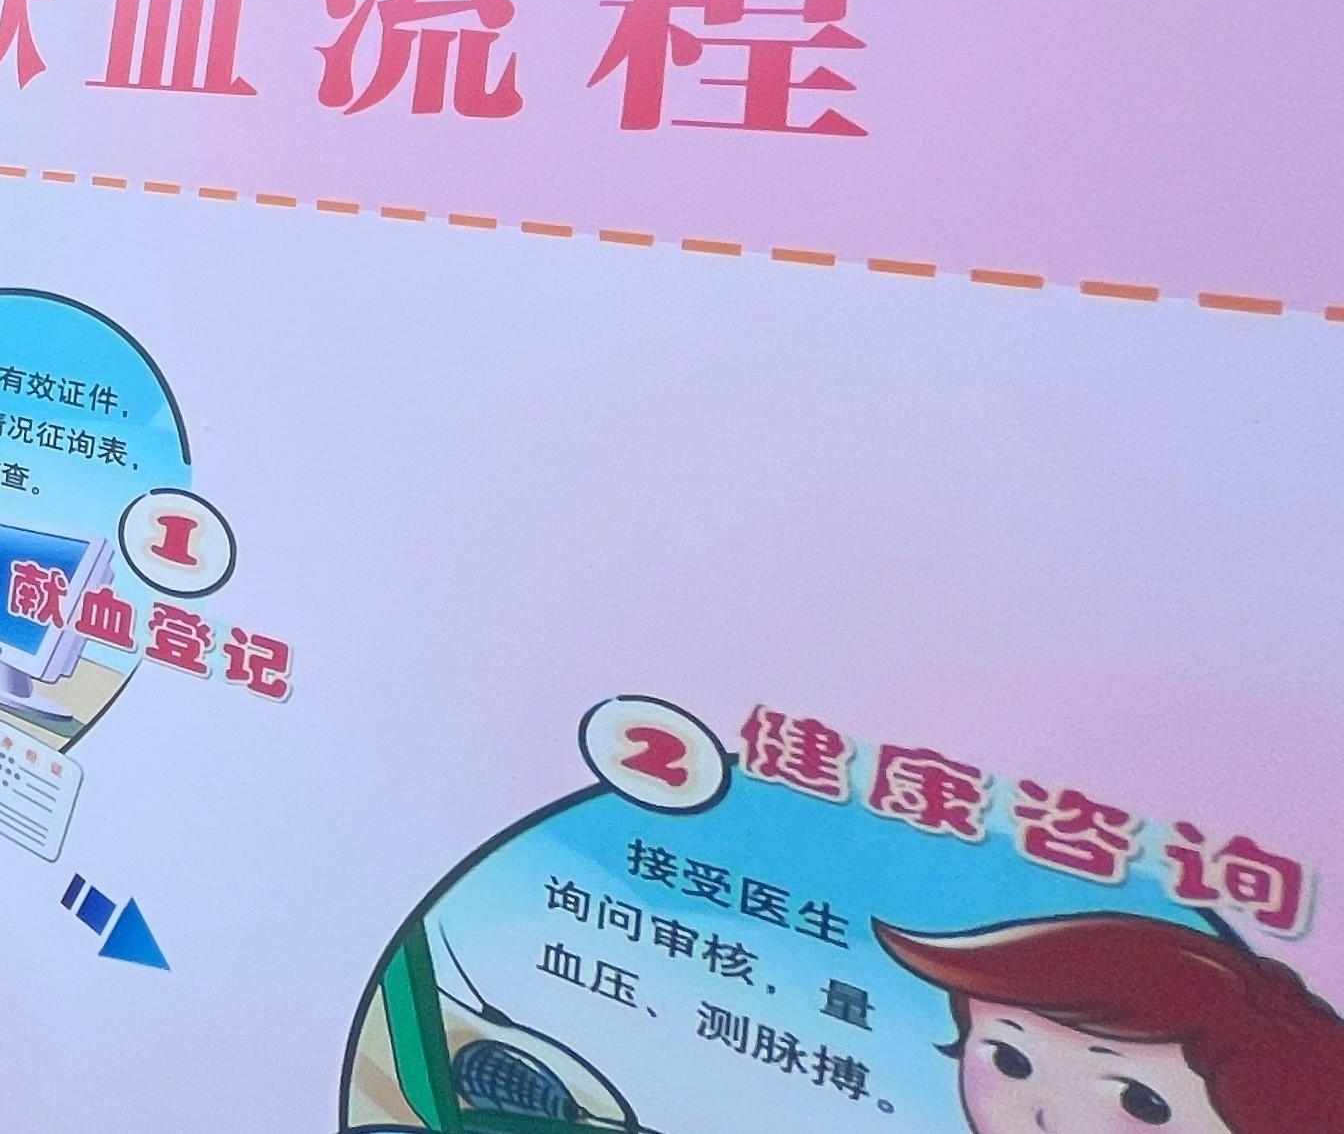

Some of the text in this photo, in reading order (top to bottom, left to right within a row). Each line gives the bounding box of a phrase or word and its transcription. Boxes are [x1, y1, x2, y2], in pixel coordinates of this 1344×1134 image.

[151, 515, 198, 567] 1
[11, 563, 290, 699] 献血登记
[621, 727, 690, 788] 2
[738, 704, 1306, 933] 健康咨询
[545, 875, 874, 1032] 询问审核，量
[626, 838, 850, 951] 接受医生
[536, 940, 895, 1116] 血压、测脉搏。
